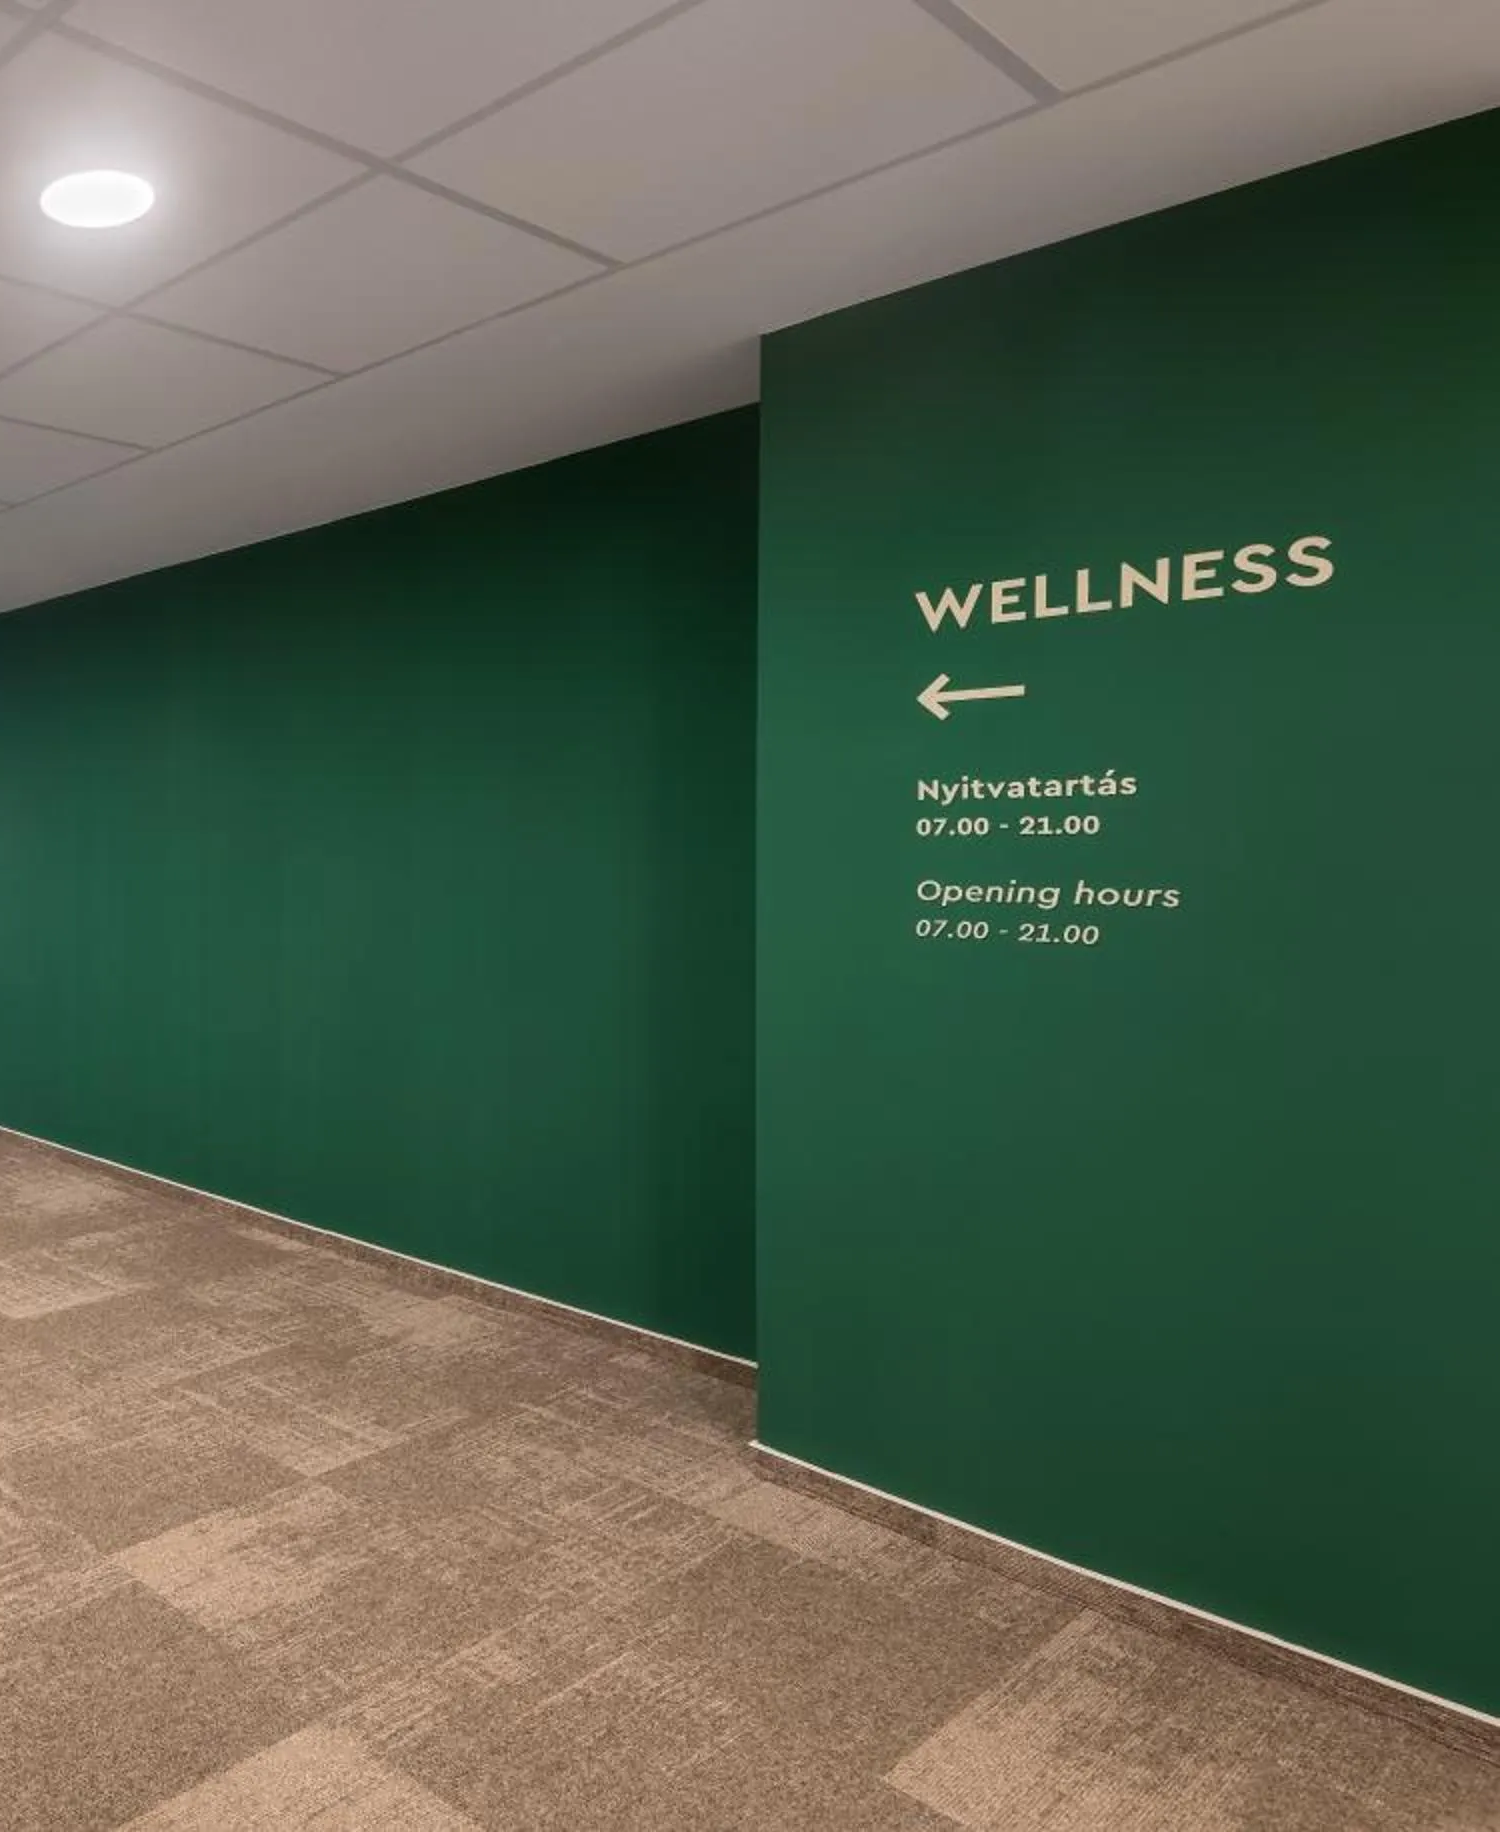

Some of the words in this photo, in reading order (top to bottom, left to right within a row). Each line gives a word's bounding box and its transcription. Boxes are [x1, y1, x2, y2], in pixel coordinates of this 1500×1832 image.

[915, 535, 1334, 633] WELLNESS
[917, 769, 1137, 806] Nyitvatartás
[915, 817, 990, 837] 07.00
[1019, 815, 1101, 835] 21.00
[916, 879, 1061, 910] Opening
[1073, 879, 1180, 908] hours
[915, 919, 989, 939] 07.00
[1018, 923, 1100, 945] 21.00
